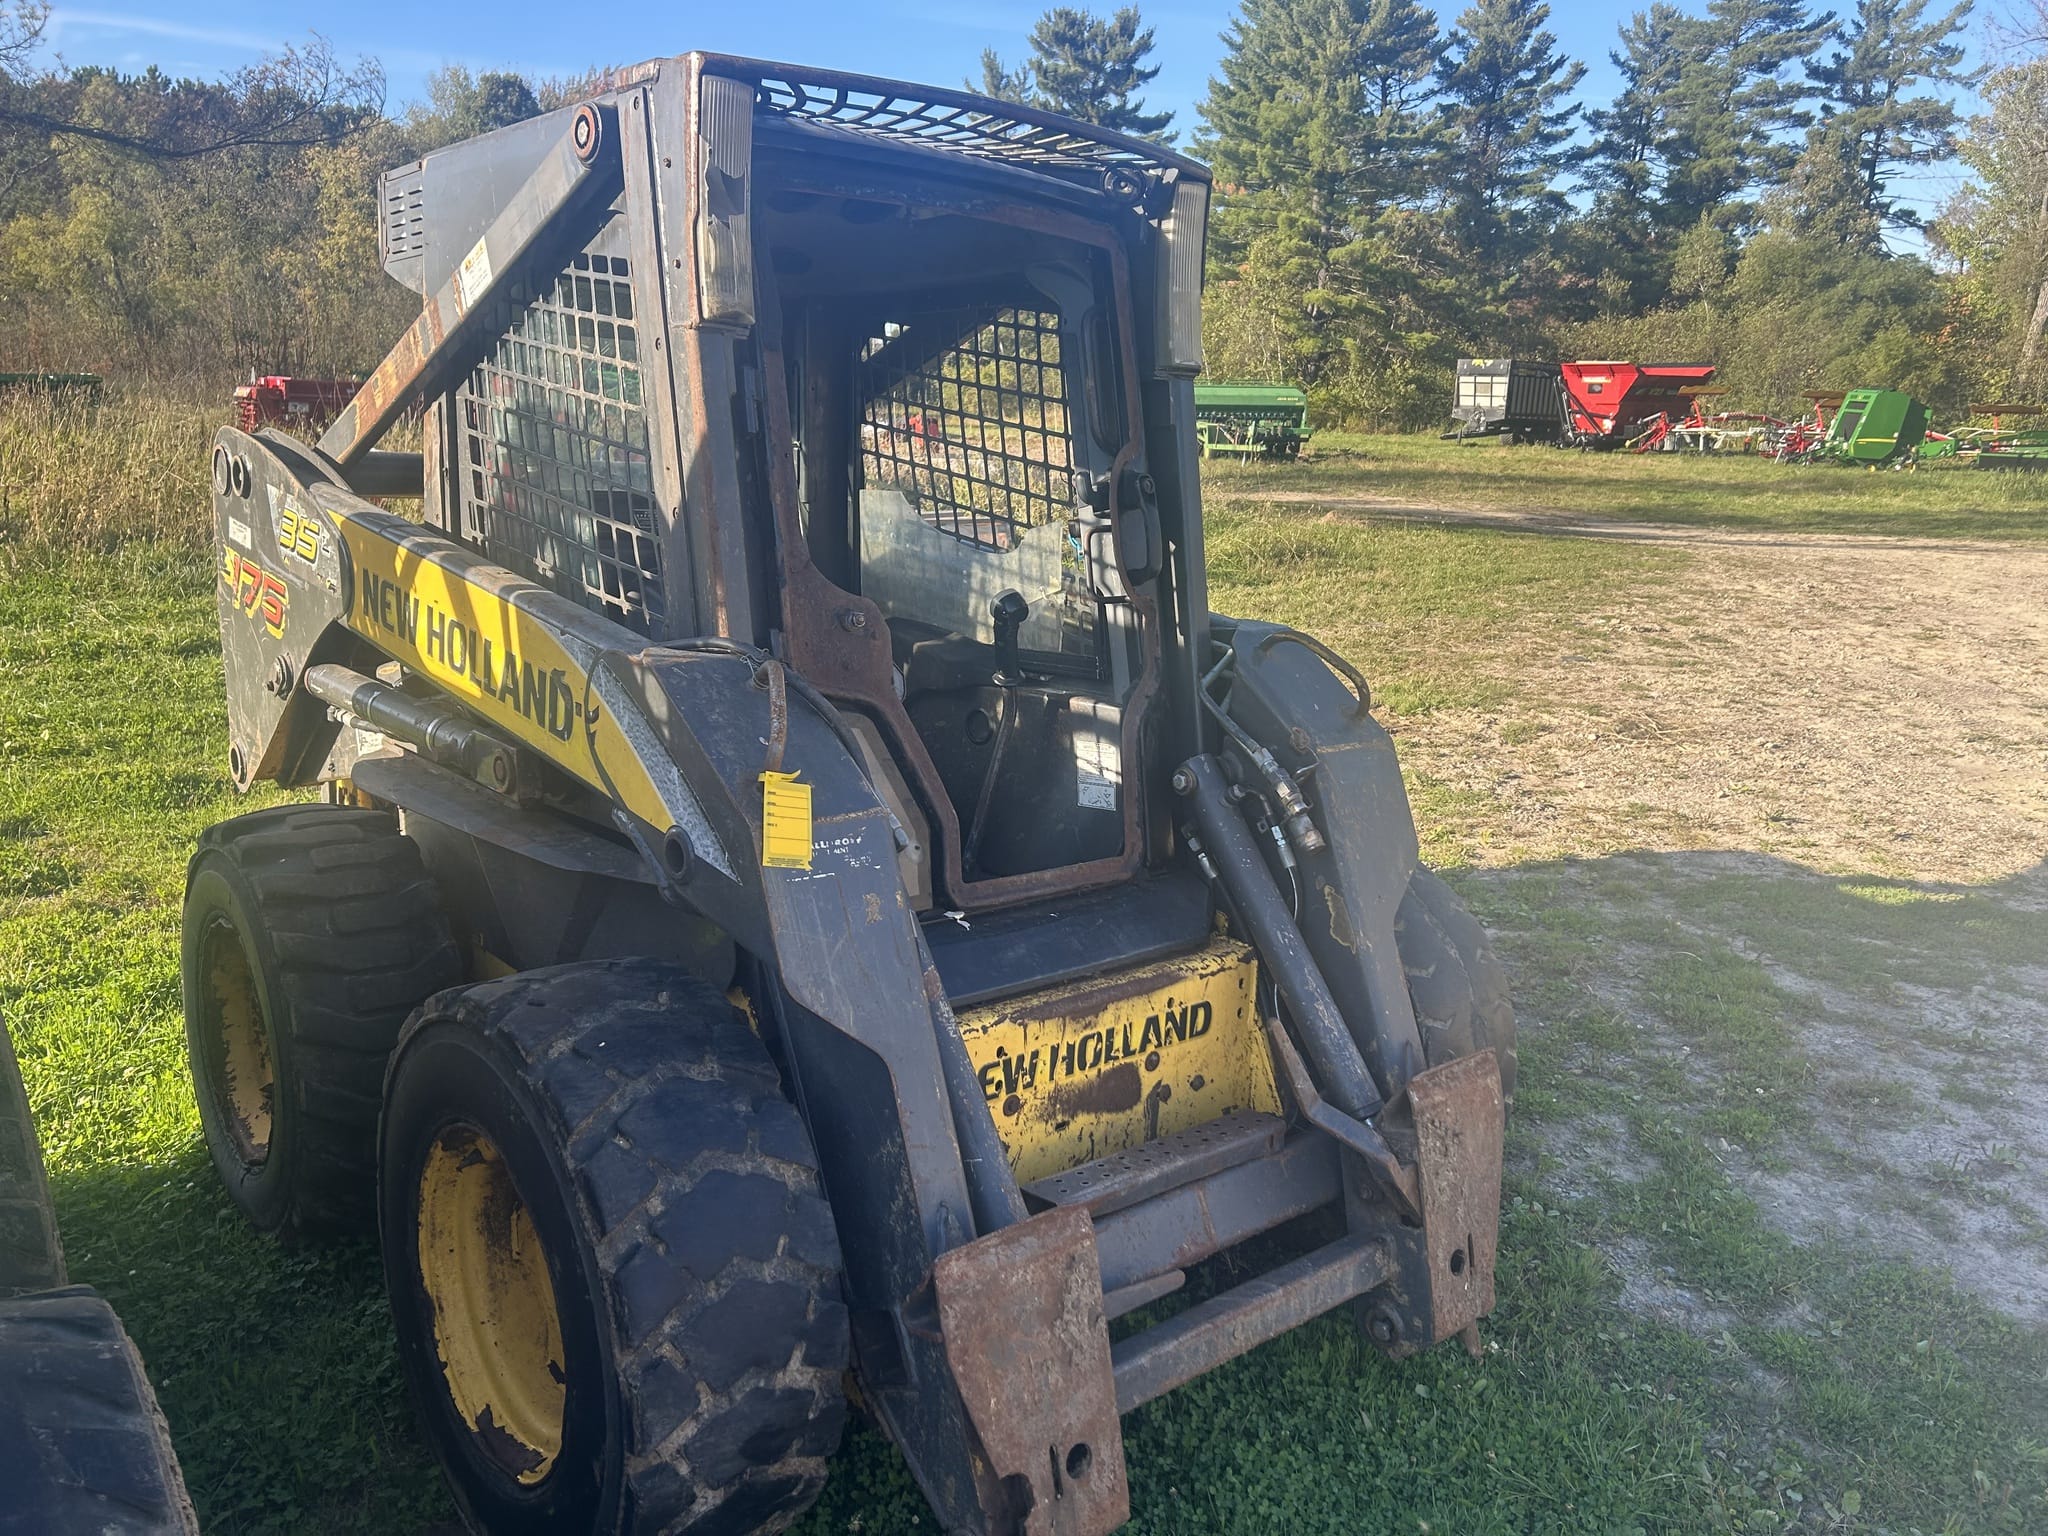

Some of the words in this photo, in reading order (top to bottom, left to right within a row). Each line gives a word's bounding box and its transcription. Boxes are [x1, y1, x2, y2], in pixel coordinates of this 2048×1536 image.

[279, 507, 321, 565] 35
[362, 567, 420, 646] NEW
[426, 603, 574, 742] HOLLAND
[976, 1050, 1039, 1101] EW
[1049, 1000, 1213, 1082] HOLLAND
